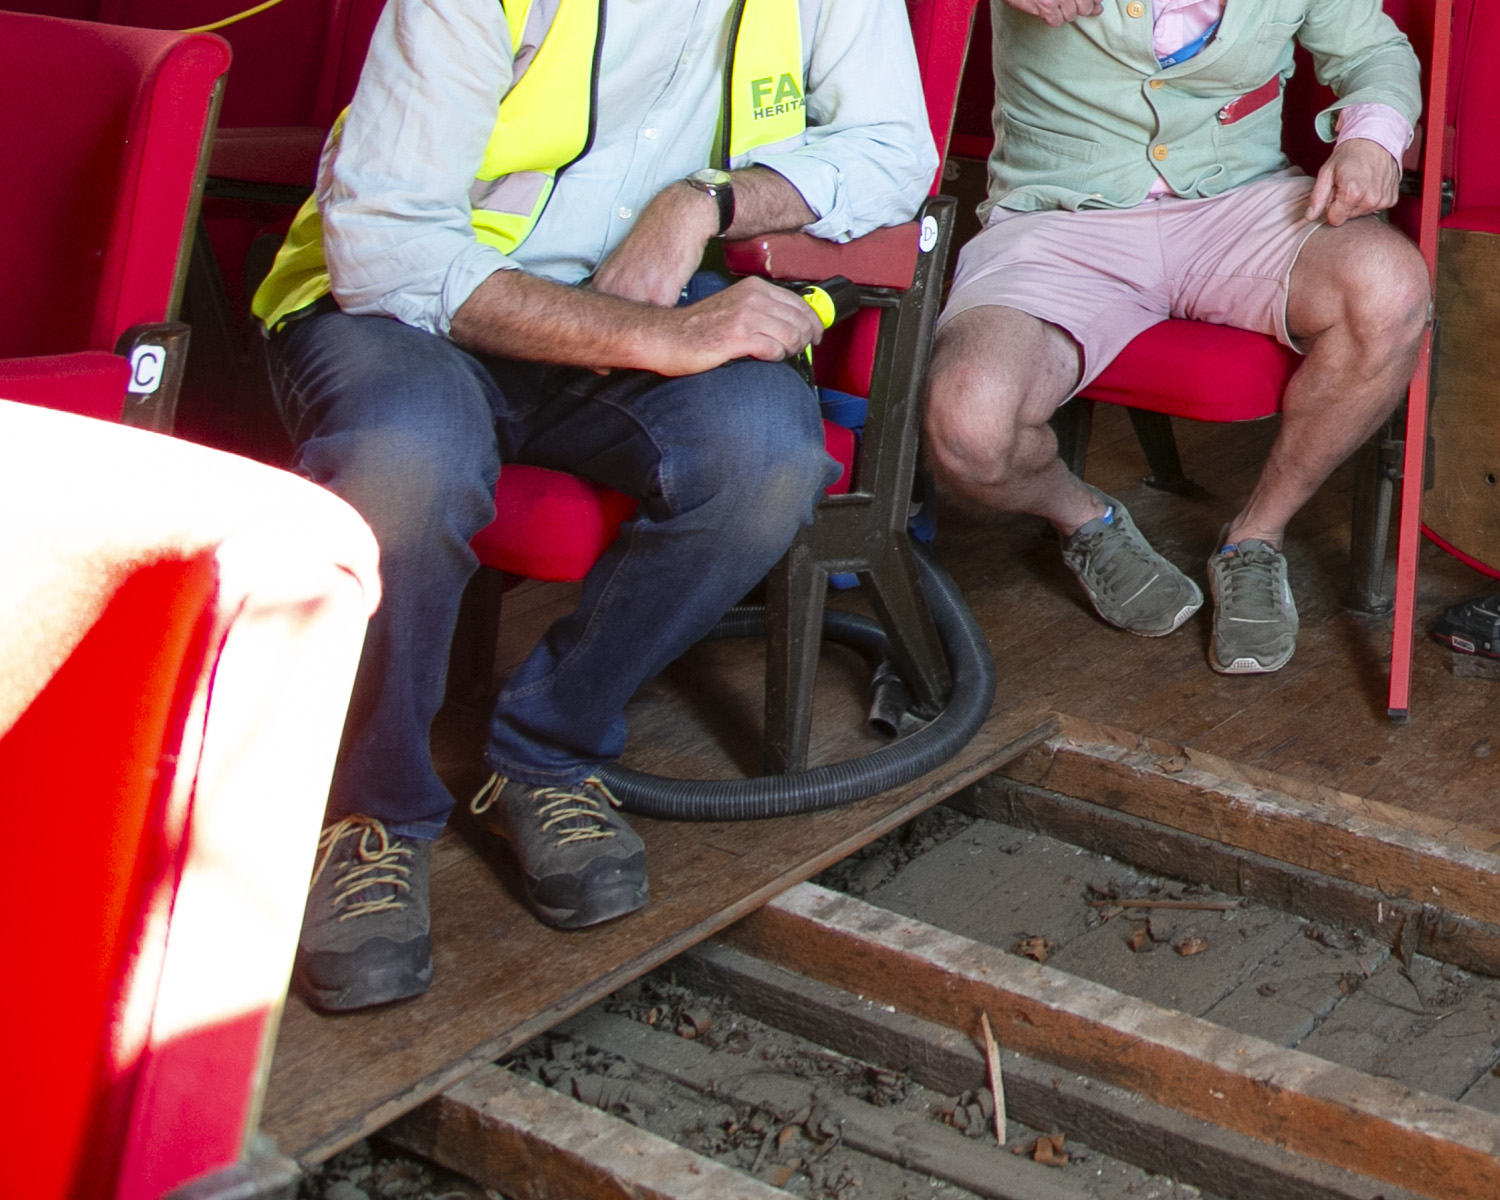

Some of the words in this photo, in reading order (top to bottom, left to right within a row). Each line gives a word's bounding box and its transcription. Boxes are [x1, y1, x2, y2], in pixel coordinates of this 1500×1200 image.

[751, 72, 802, 109] FA
[923, 226, 933, 242] D
[134, 352, 158, 387] C
